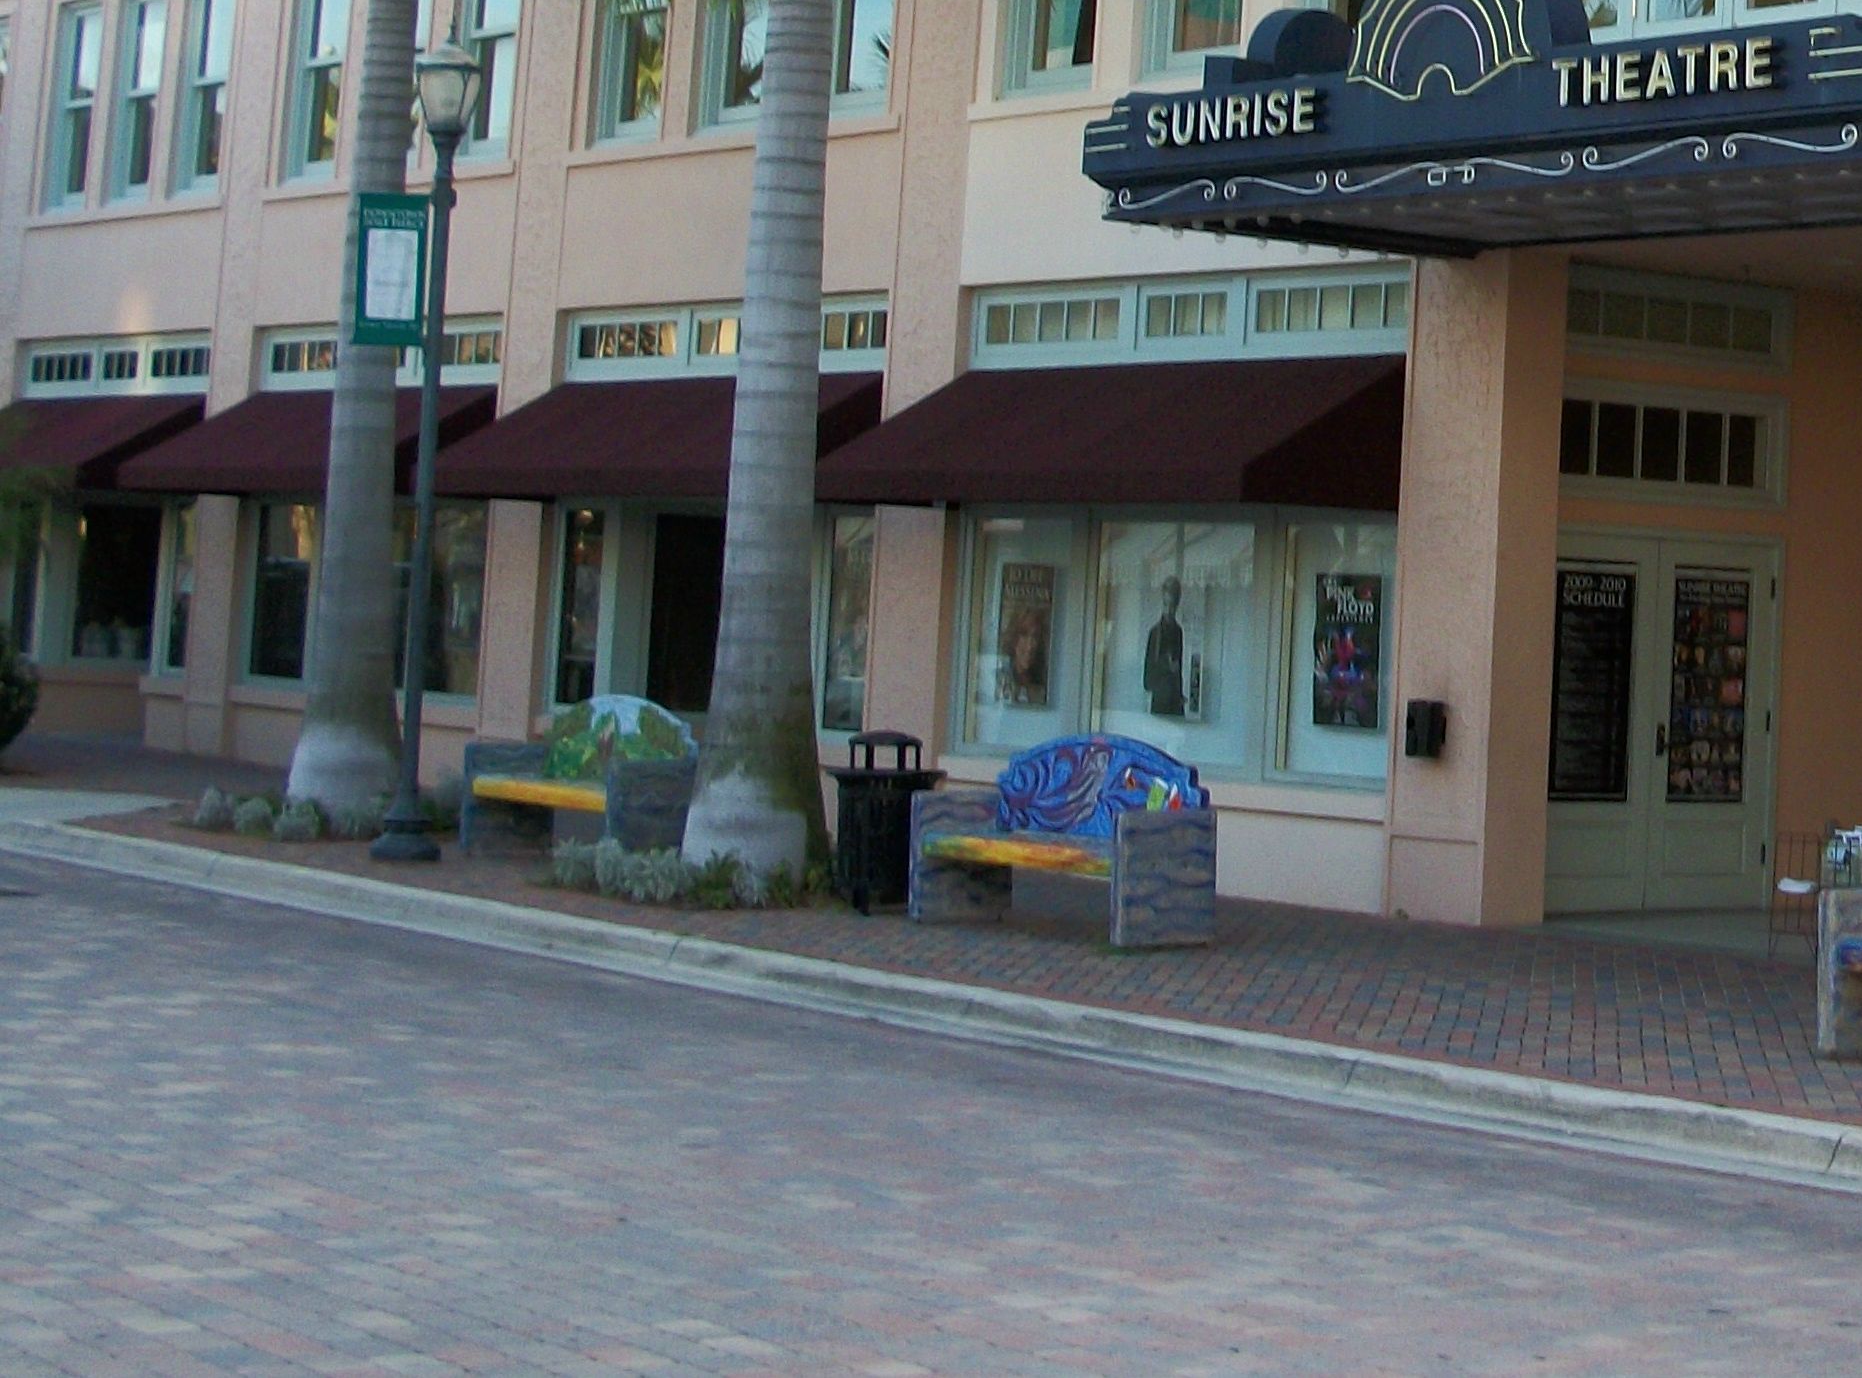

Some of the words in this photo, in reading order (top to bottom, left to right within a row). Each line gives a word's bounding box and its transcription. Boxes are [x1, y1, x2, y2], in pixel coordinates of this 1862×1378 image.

[1551, 36, 1774, 108] THEATRE
[1145, 86, 1317, 149] SUNRISE
[1336, 595, 1375, 616] FLOYD
[1563, 589, 1625, 608] SCHEDULE
